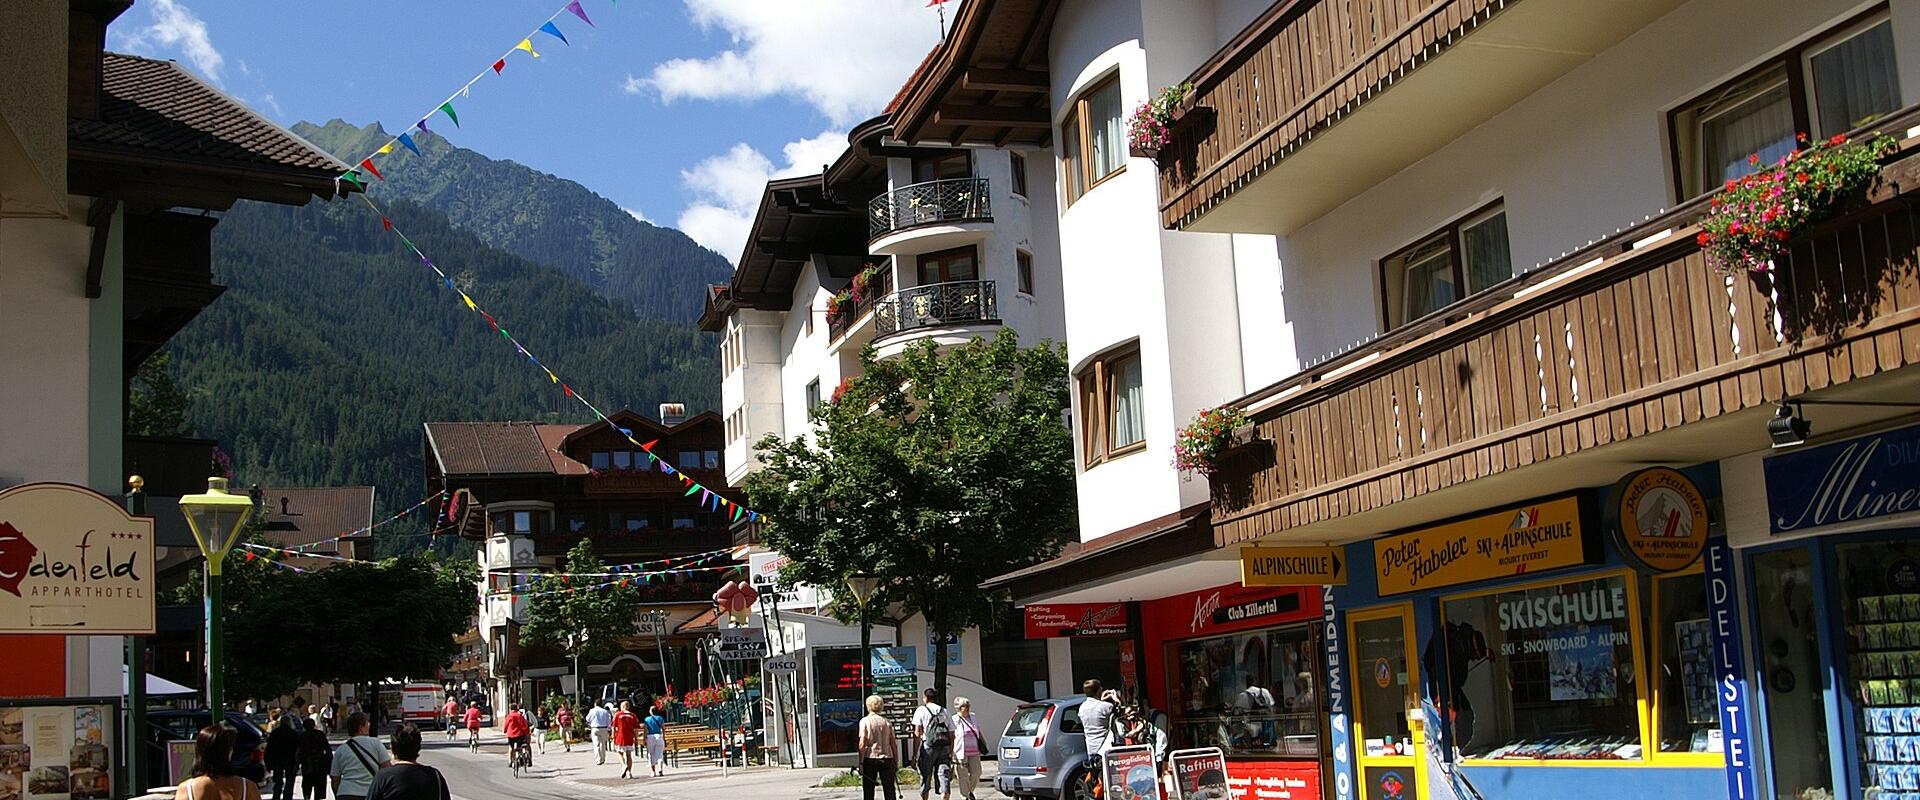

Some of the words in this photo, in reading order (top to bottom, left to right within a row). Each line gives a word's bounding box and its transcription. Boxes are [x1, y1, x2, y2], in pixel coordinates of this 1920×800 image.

[1476, 538, 1492, 559] SKI
[1498, 553, 1521, 567] MOUNT
[1522, 550, 1549, 563] EVEREST
[1252, 556, 1329, 576] ALPINSCHULE
[1382, 537, 1421, 577] Peter
[1406, 536, 1469, 586] Habeler
[31, 585, 143, 598] APPARTHOTEL
[1228, 605, 1245, 620] Club
[1245, 599, 1278, 618] Zillertal
[1498, 586, 1625, 631] SKISCHULE
[1501, 643, 1515, 656] SKI
[1523, 636, 1588, 654] SNOWBOARD
[1597, 631, 1628, 647] ALPIN
[769, 661, 797, 670] DISCO
[1109, 755, 1151, 767] Paragliding
[1179, 760, 1220, 774] Rafting
